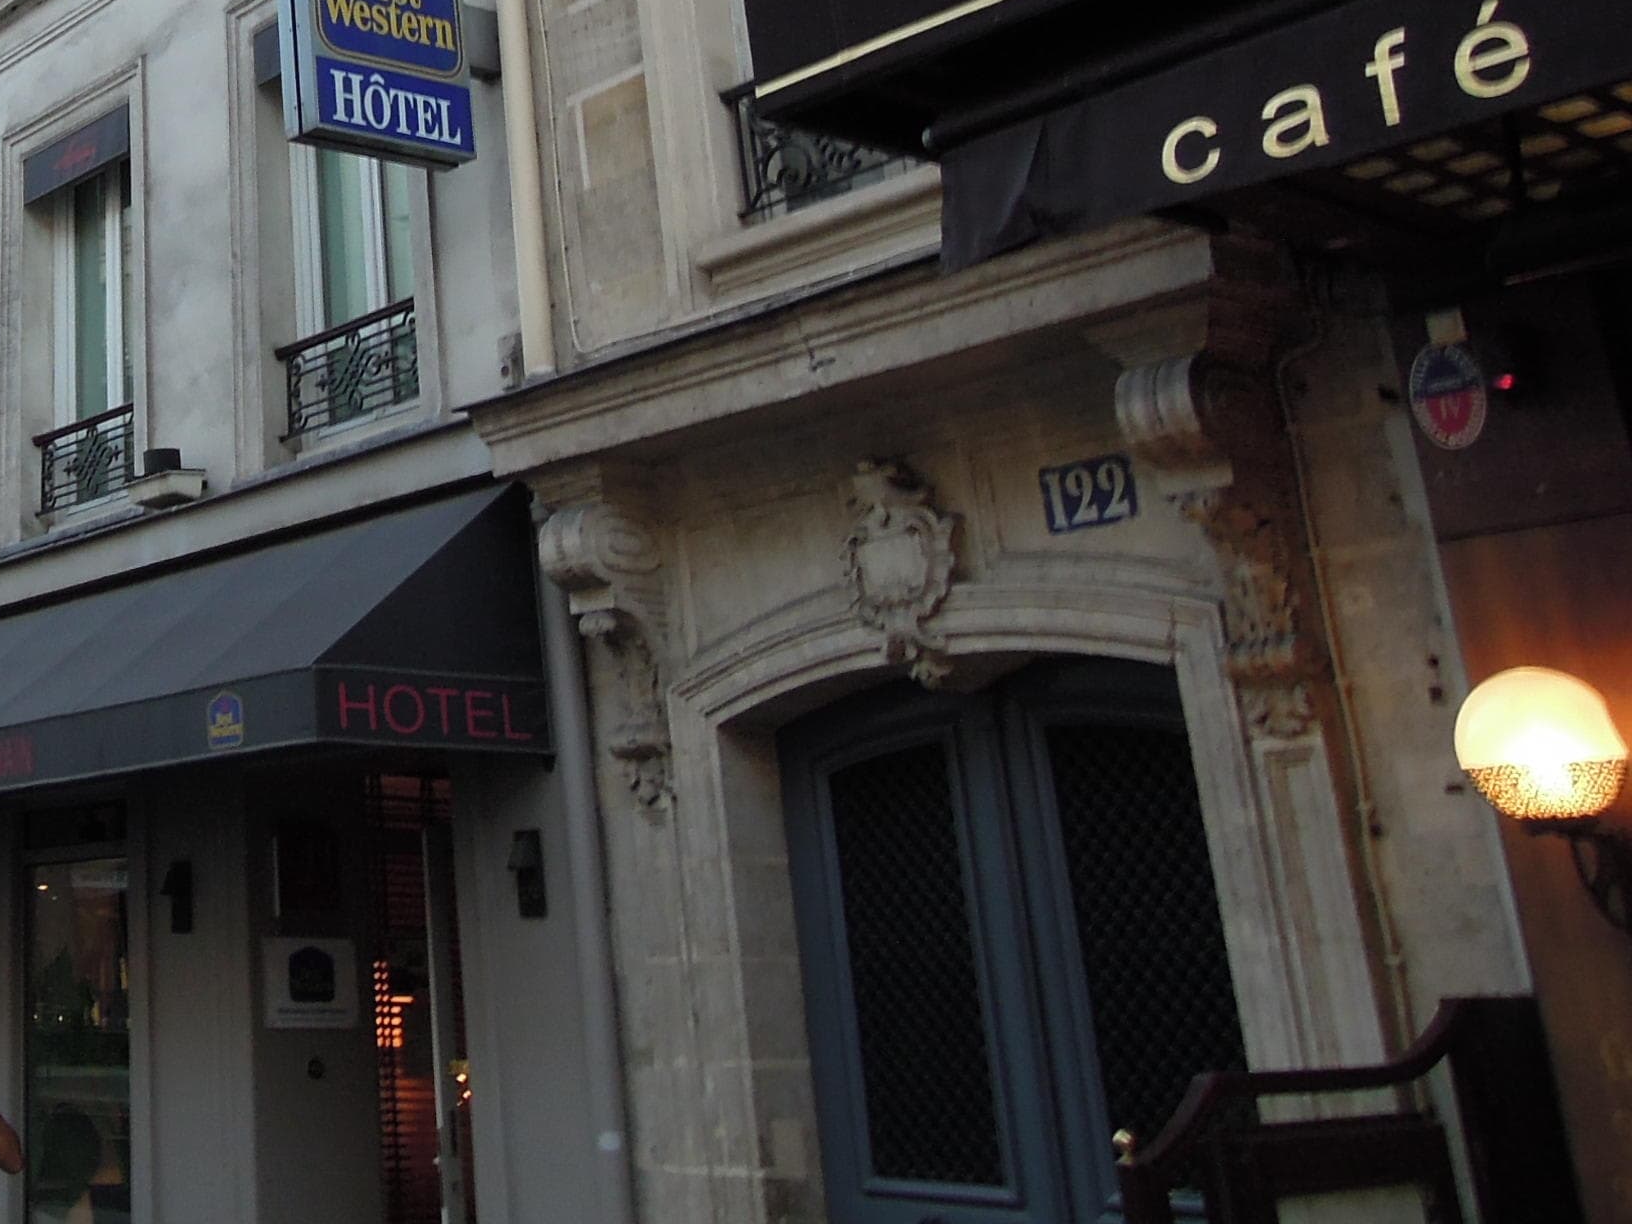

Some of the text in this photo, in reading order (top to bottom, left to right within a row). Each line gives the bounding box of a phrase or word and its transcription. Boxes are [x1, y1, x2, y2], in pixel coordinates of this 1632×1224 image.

[330, 67, 463, 146] HÔTEL
[1044, 462, 1131, 530] 122
[337, 681, 535, 740] HOTEL
